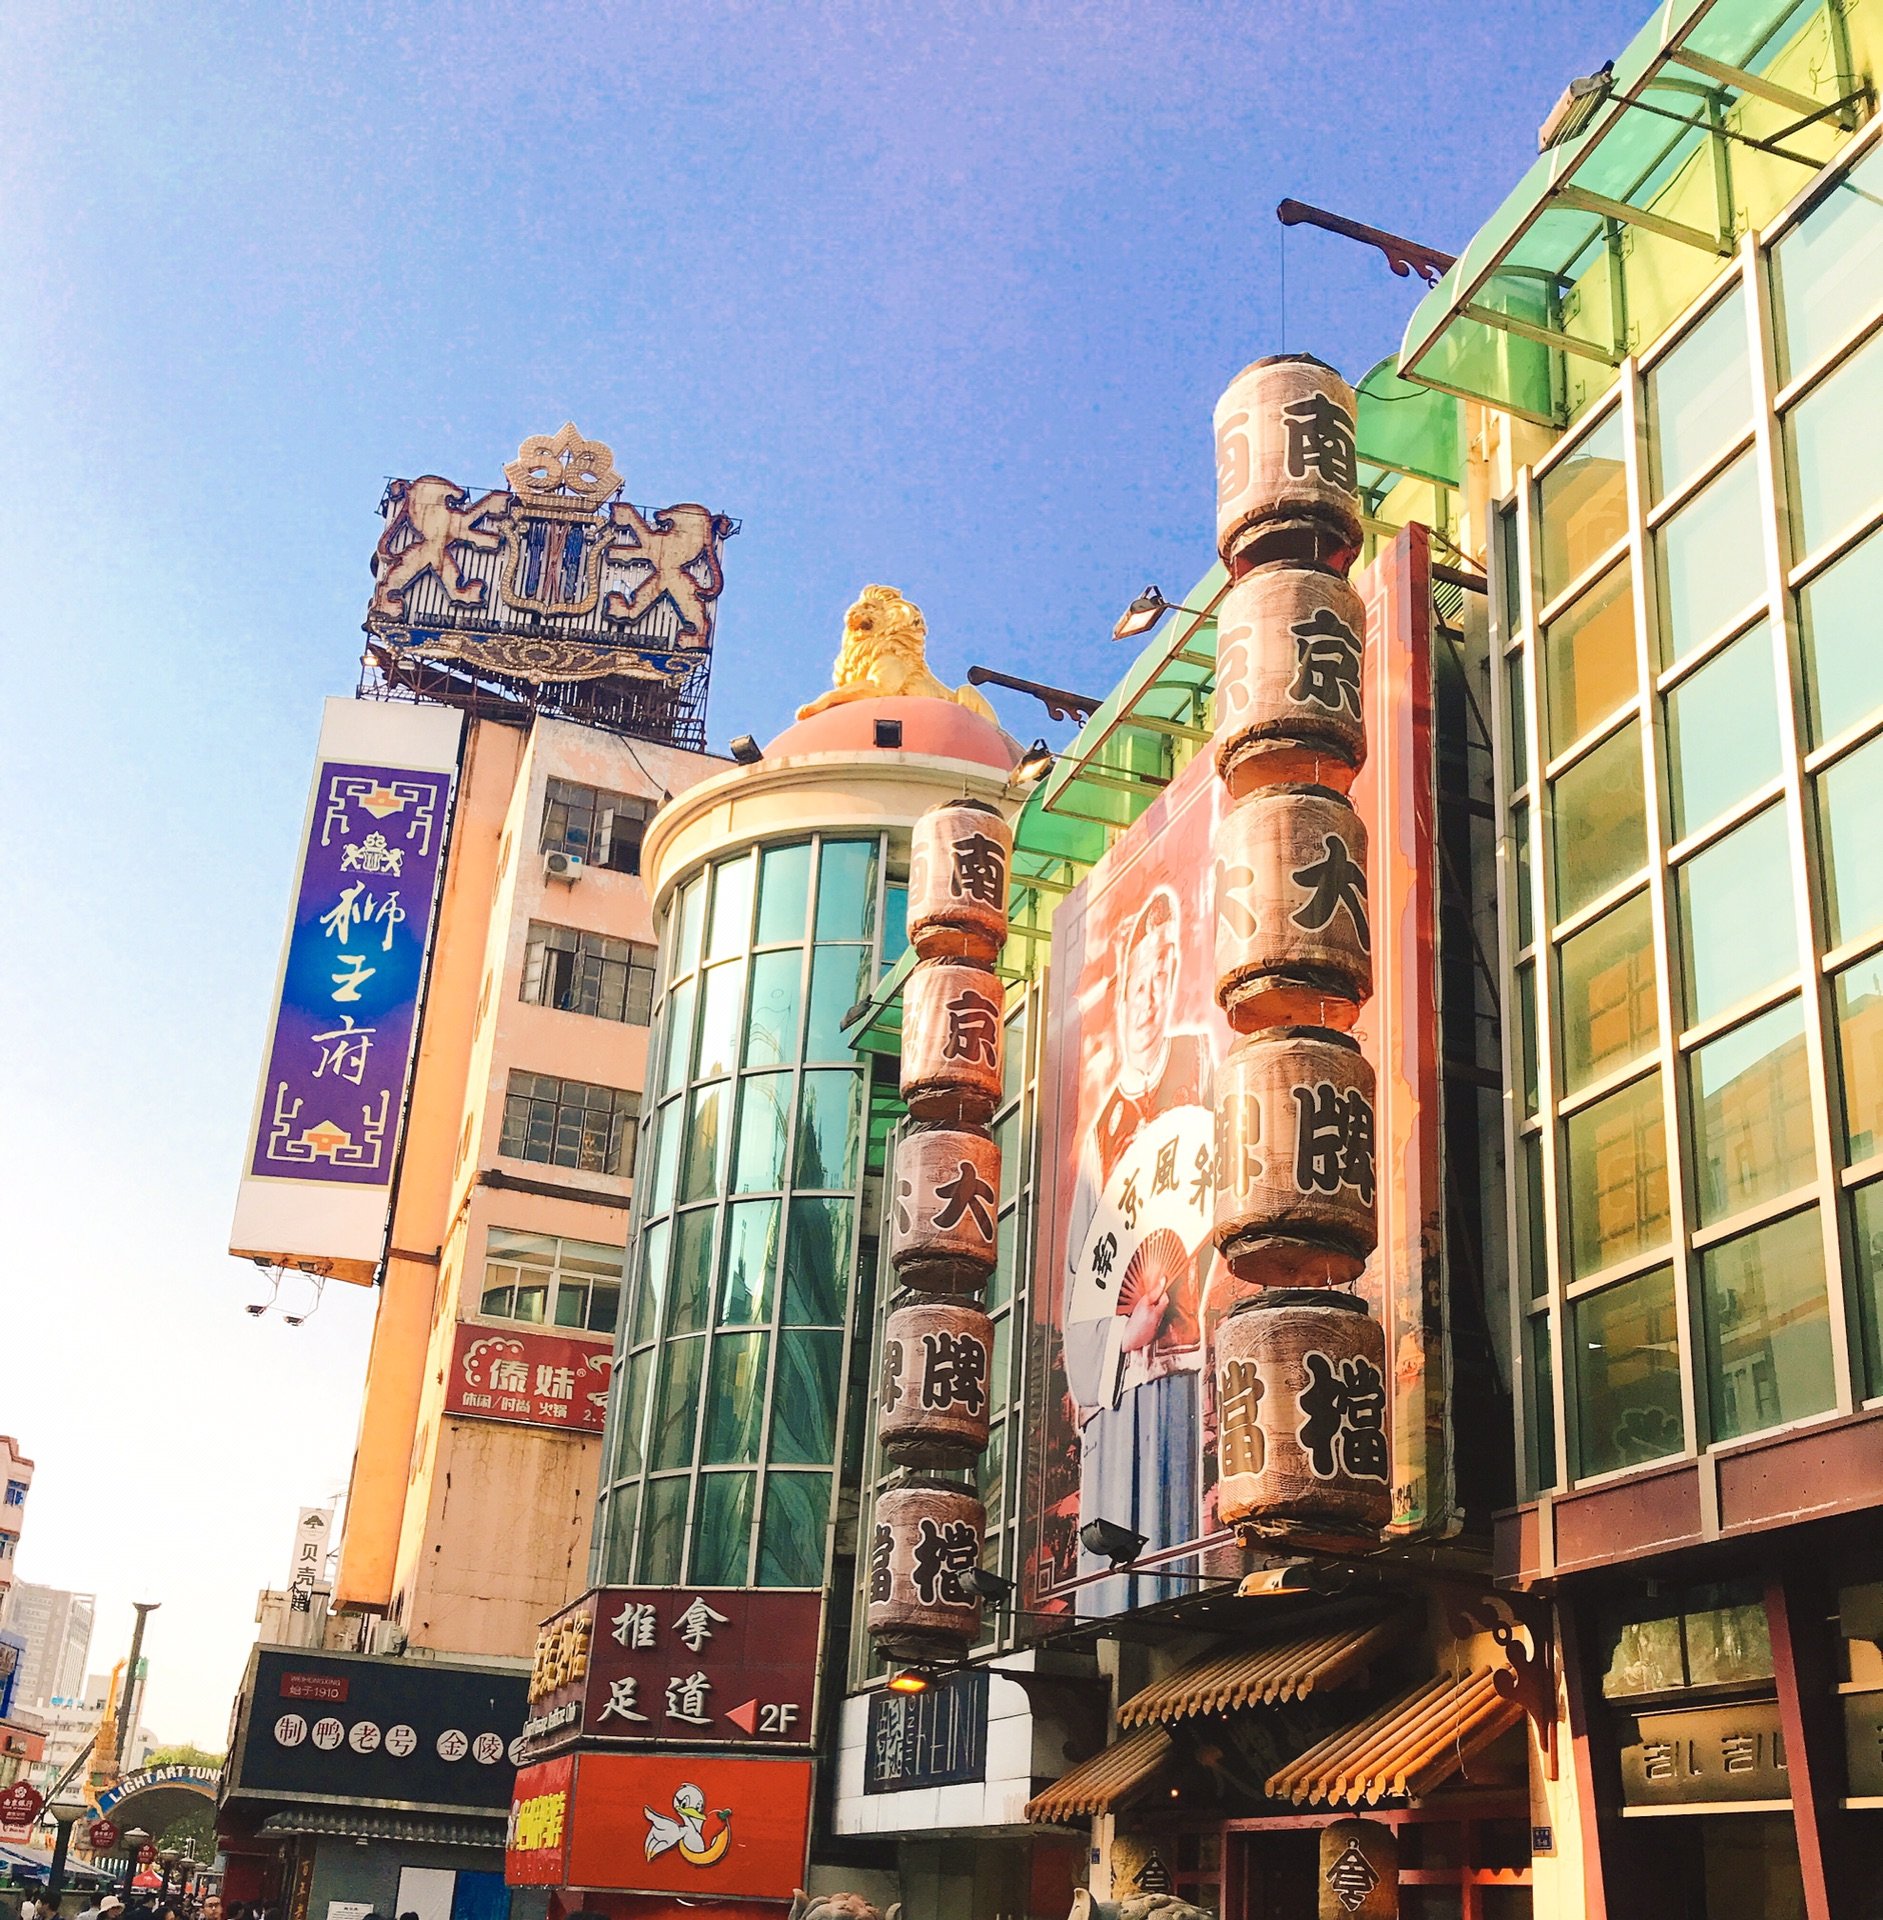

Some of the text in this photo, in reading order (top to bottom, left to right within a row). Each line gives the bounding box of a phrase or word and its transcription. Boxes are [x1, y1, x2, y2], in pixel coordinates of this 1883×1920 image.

[489, 1357, 576, 1400] 傣妹
[539, 1402, 568, 1419] 火锅
[611, 1596, 729, 1652] 推拿
[596, 1671, 714, 1724] 足道
[759, 1703, 800, 1733] 2F
[276, 1715, 415, 1756] 制鸭老号
[108, 1771, 154, 1804] LIGHT
[156, 1765, 186, 1783] ART
